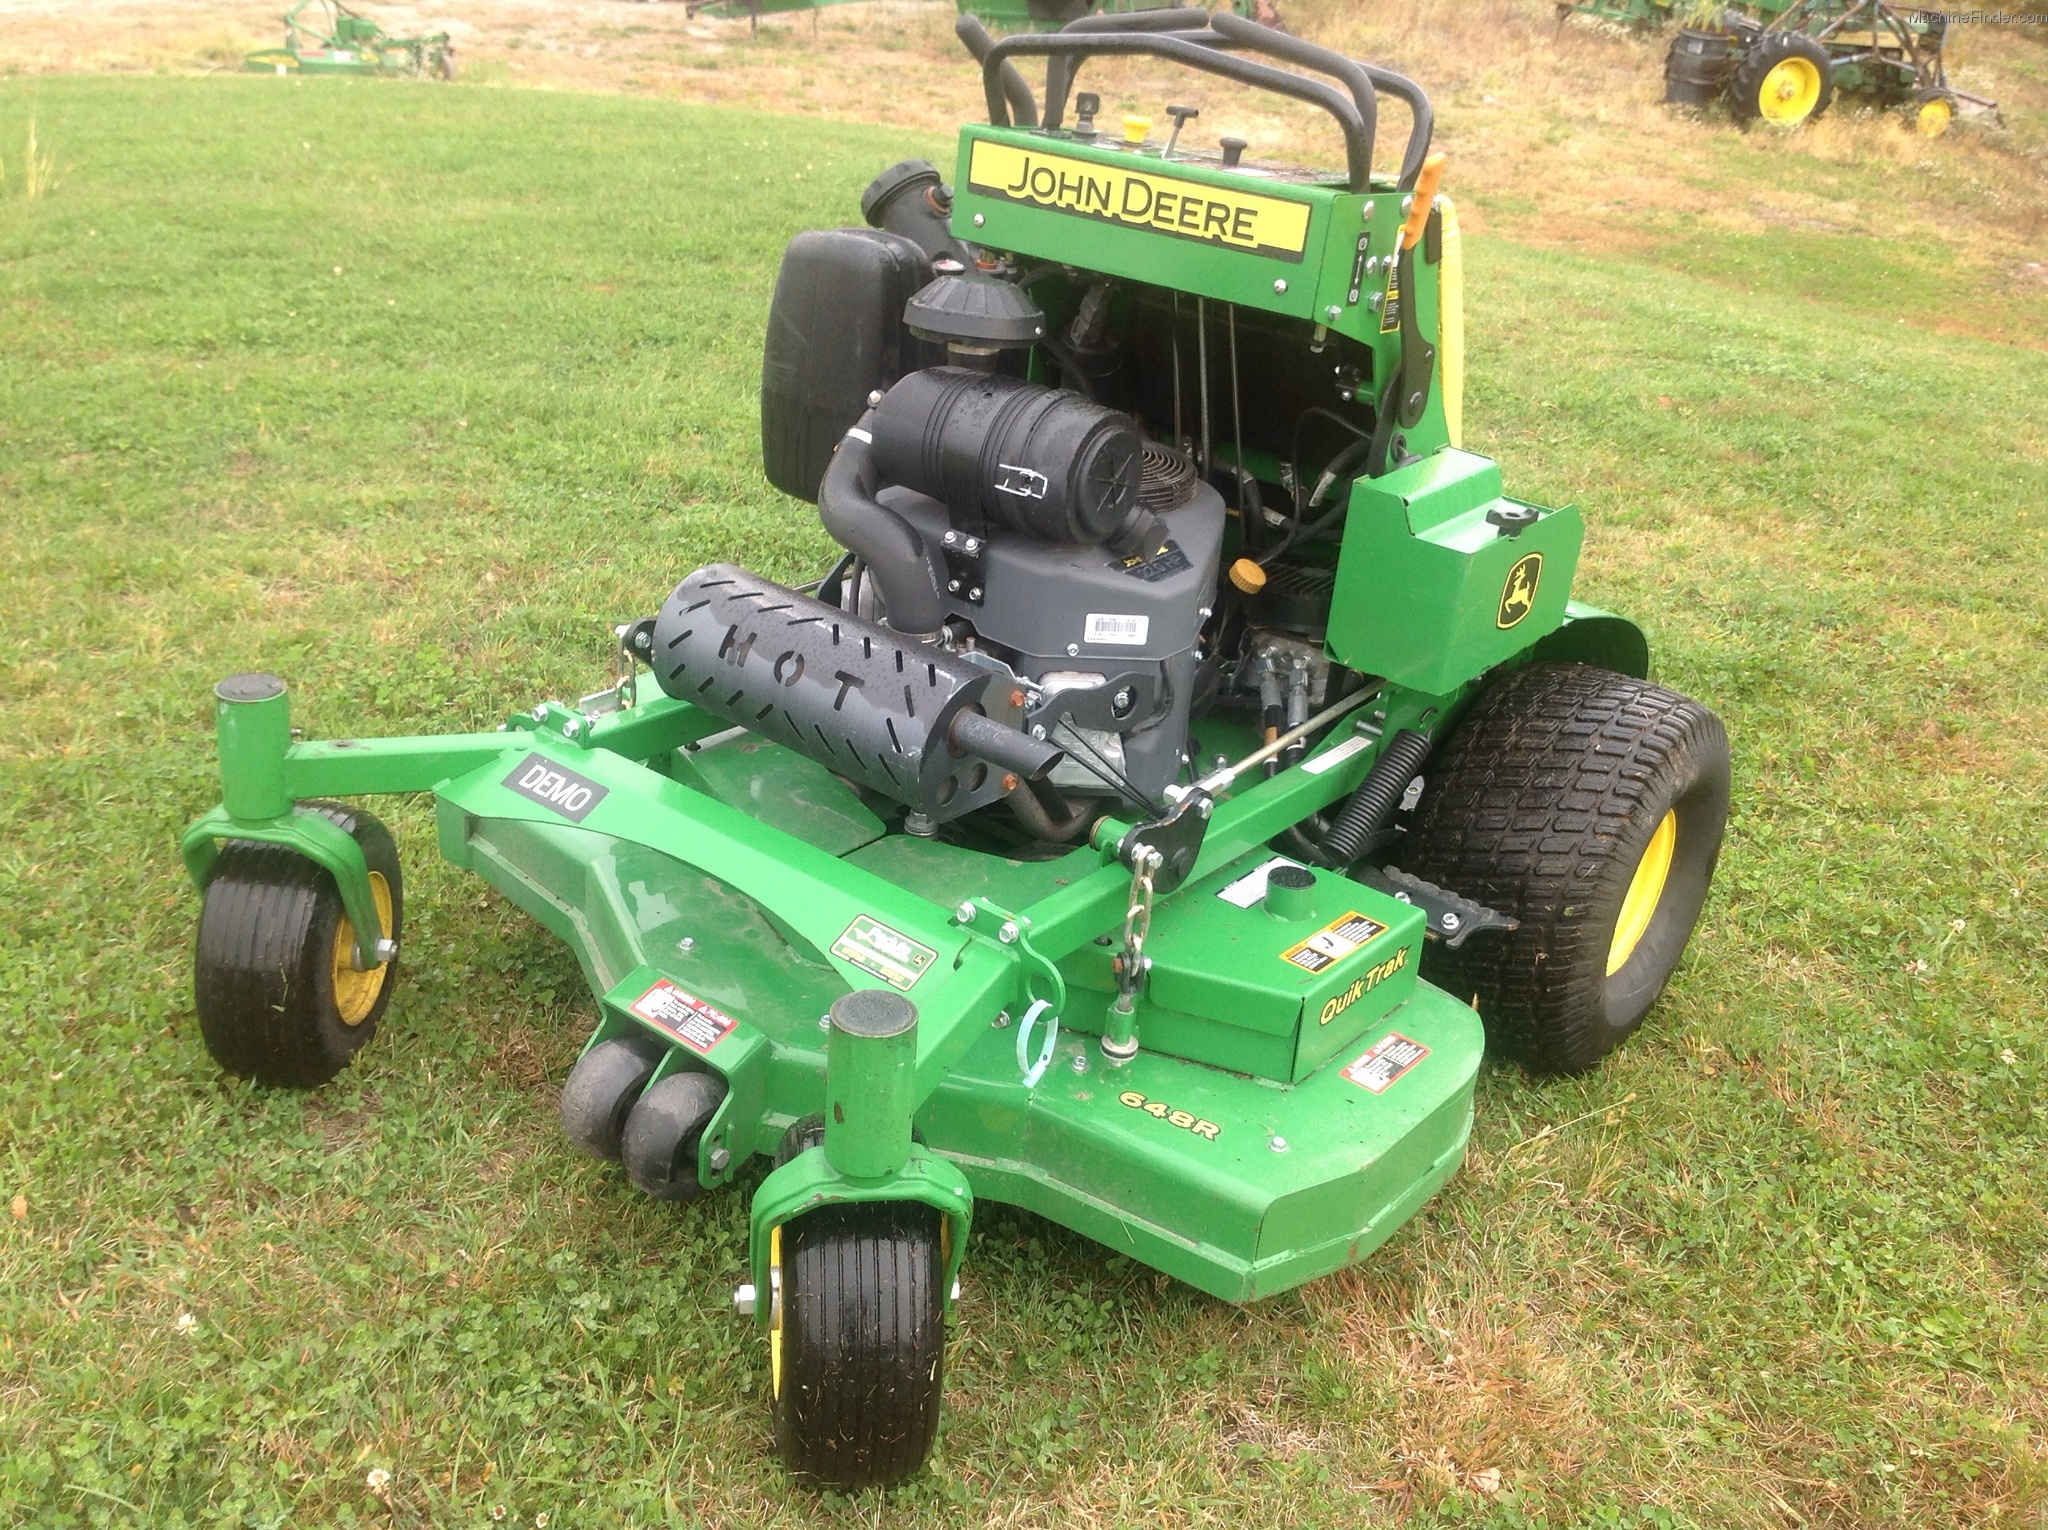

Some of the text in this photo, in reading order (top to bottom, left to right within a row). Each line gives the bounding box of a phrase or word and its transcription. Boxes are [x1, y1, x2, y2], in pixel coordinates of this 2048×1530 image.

[1008, 157, 1259, 241] JOHN DEERE
[718, 624, 865, 711] HOT
[518, 764, 592, 812] DEMO
[1119, 1091, 1221, 1142] 648R
